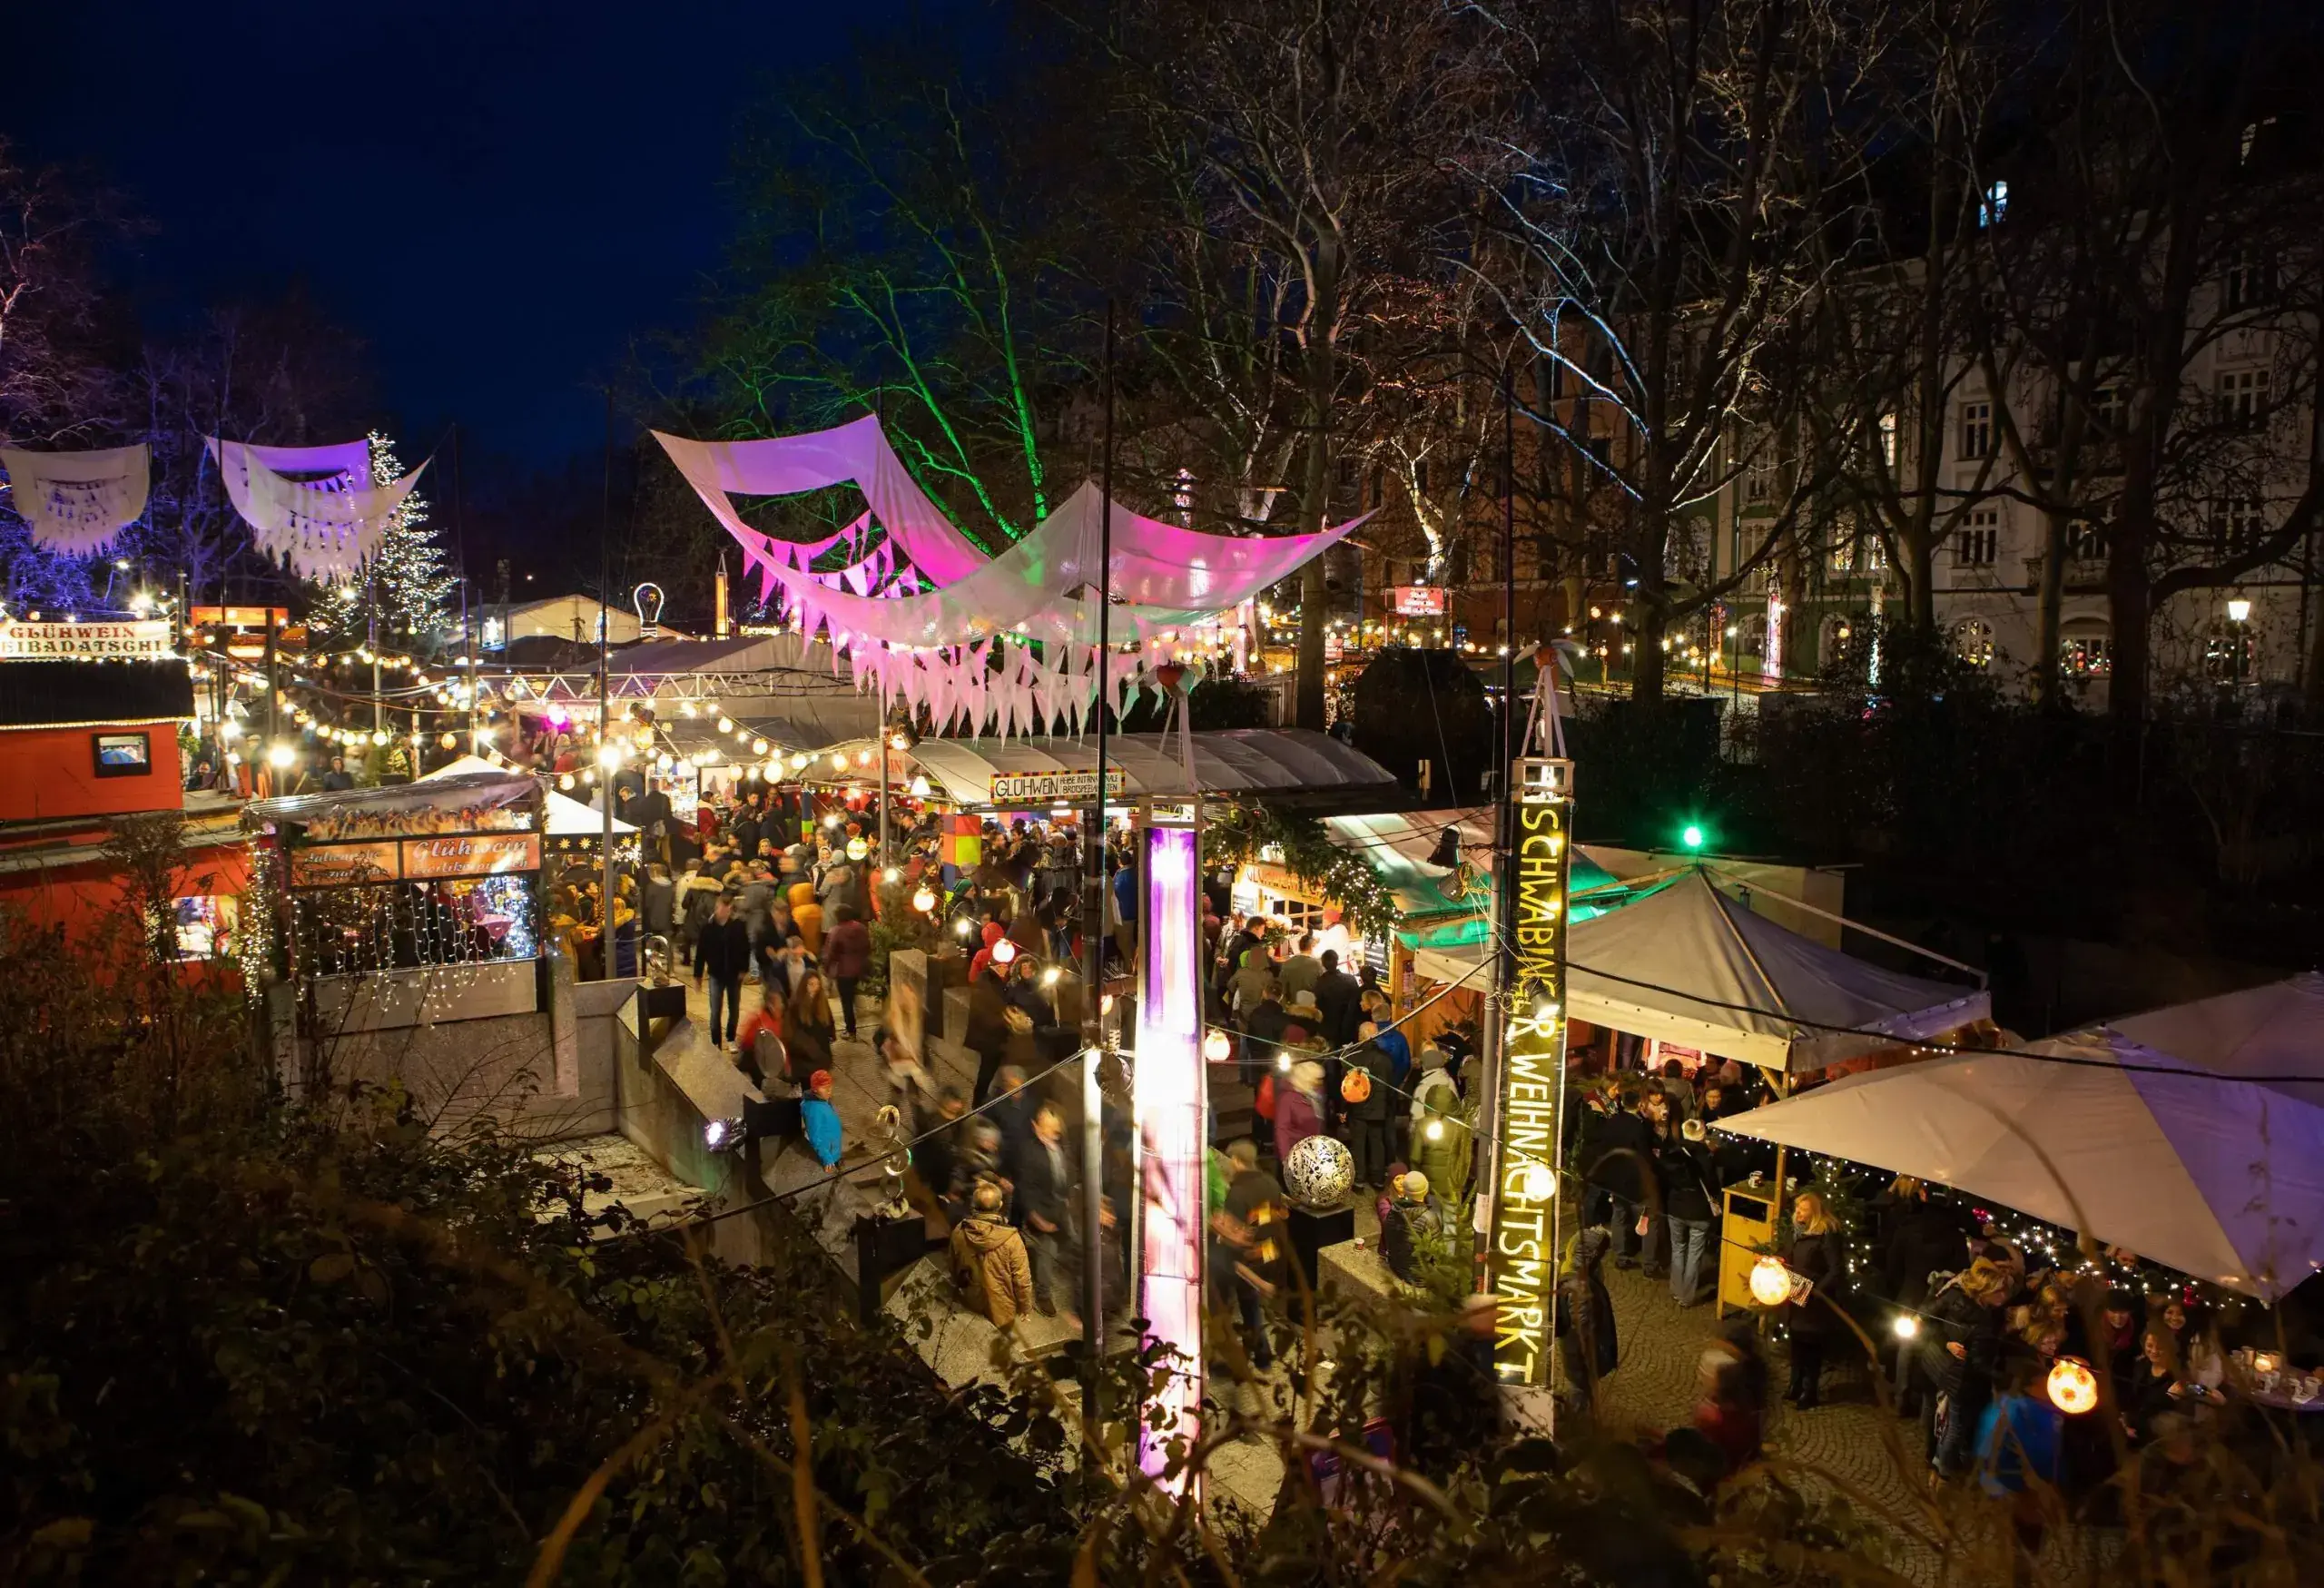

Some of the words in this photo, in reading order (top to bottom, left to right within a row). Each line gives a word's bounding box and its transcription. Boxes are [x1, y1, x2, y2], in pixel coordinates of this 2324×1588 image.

[10, 625, 134, 638] GLÜHWEIN
[995, 778, 1059, 796] GLÜHWEIN
[413, 837, 527, 859] Glühwein
